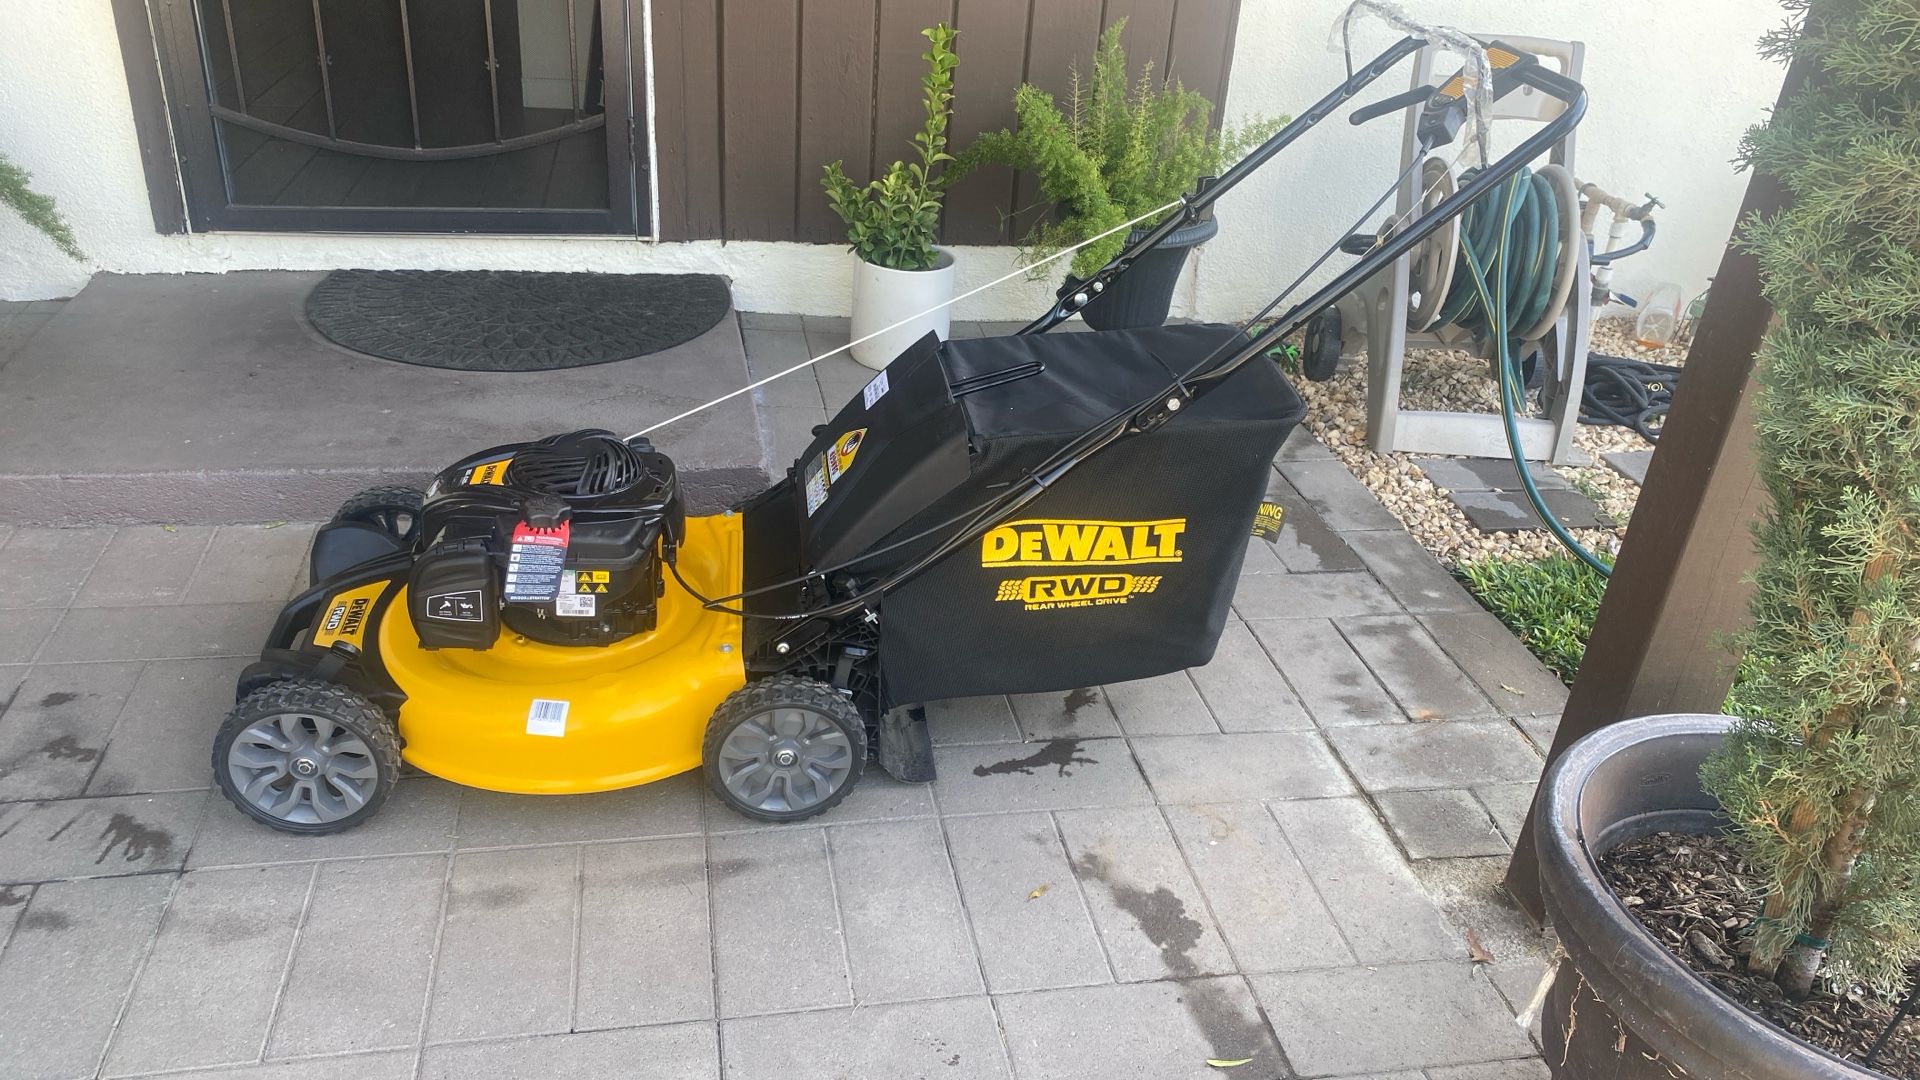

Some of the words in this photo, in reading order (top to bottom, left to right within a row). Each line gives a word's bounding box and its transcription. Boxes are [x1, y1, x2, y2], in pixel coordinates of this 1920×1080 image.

[1257, 503, 1284, 520] NING
[981, 522, 1186, 563] DEWALT
[1029, 576, 1126, 599] RWD
[1024, 602, 1055, 611] REAR
[1056, 600, 1094, 609] WHEEL
[1095, 597, 1128, 606] DRIVE
[326, 606, 346, 630] RWD
[340, 598, 370, 636] DEWALT
